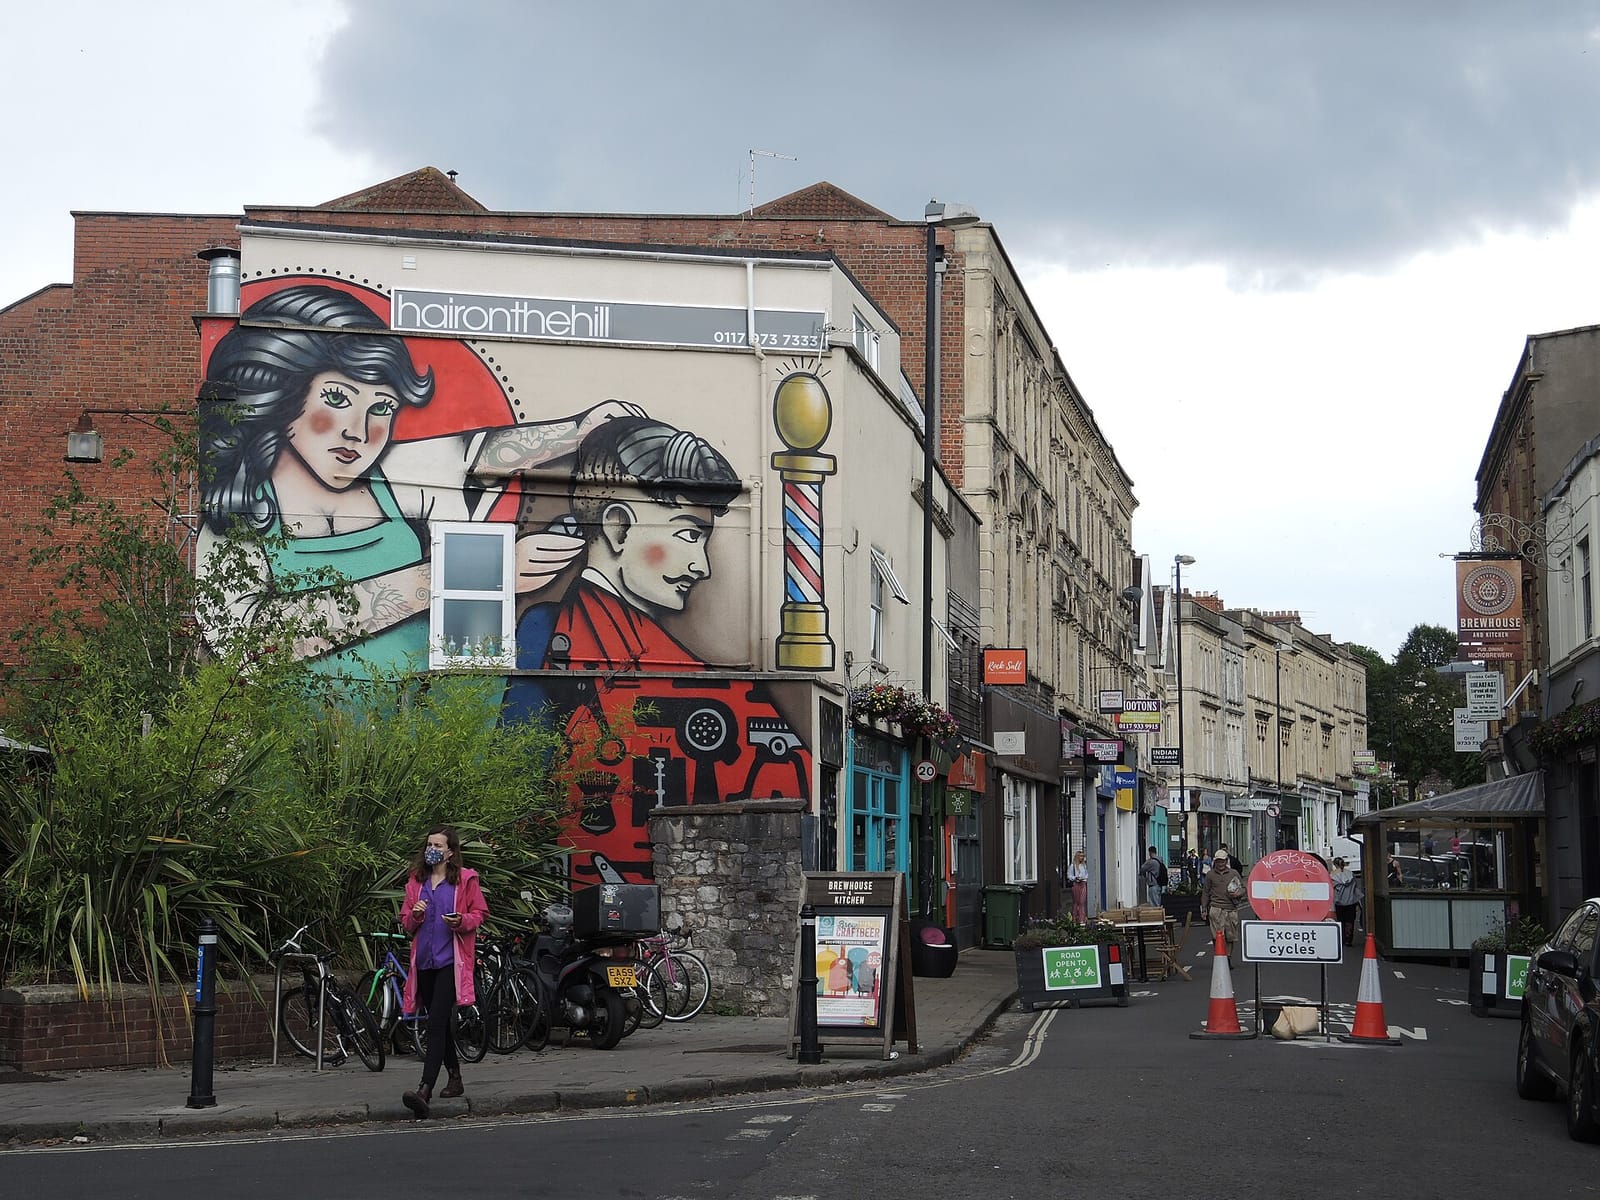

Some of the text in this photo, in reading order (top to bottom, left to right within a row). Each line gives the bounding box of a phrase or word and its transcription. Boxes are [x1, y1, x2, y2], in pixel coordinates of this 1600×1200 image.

[398, 294, 609, 338] haironthehill
[714, 331, 746, 344] 0117
[783, 334, 818, 347] 7333
[1460, 617, 1521, 628] BREWHOUSE
[918, 766, 935, 776] 20
[828, 881, 873, 890] BREWHOUSE
[834, 896, 865, 905] KITCHEN
[1267, 929, 1317, 942] Except
[1269, 943, 1315, 956] cycles
[1060, 952, 1081, 960] ROAD
